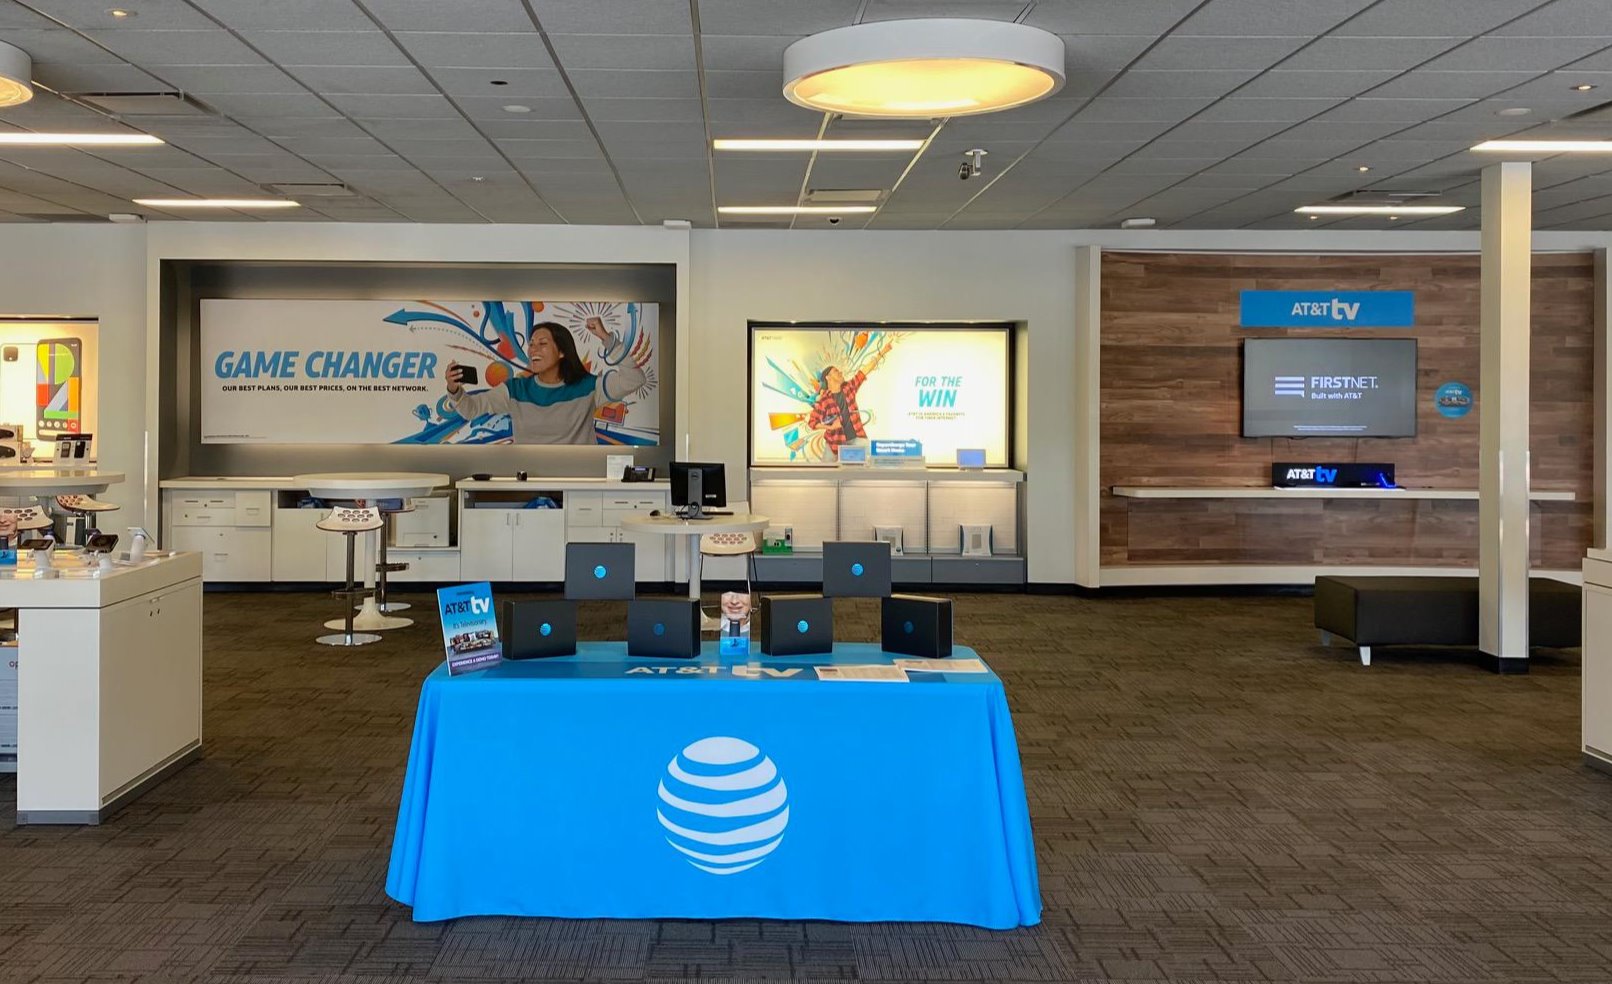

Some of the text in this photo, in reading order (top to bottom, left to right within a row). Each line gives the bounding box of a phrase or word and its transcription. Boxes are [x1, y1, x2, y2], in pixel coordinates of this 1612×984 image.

[1291, 297, 1360, 321] AT&T tv
[214, 351, 437, 379] GAME CHANGER
[914, 376, 963, 387] FOR THE
[918, 389, 957, 408] WIN
[1311, 392, 1362, 400] Built with AT&T
[1286, 466, 1338, 483] AT&T tv
[445, 595, 490, 616] AT&T tv
[625, 666, 727, 675] AT&T
